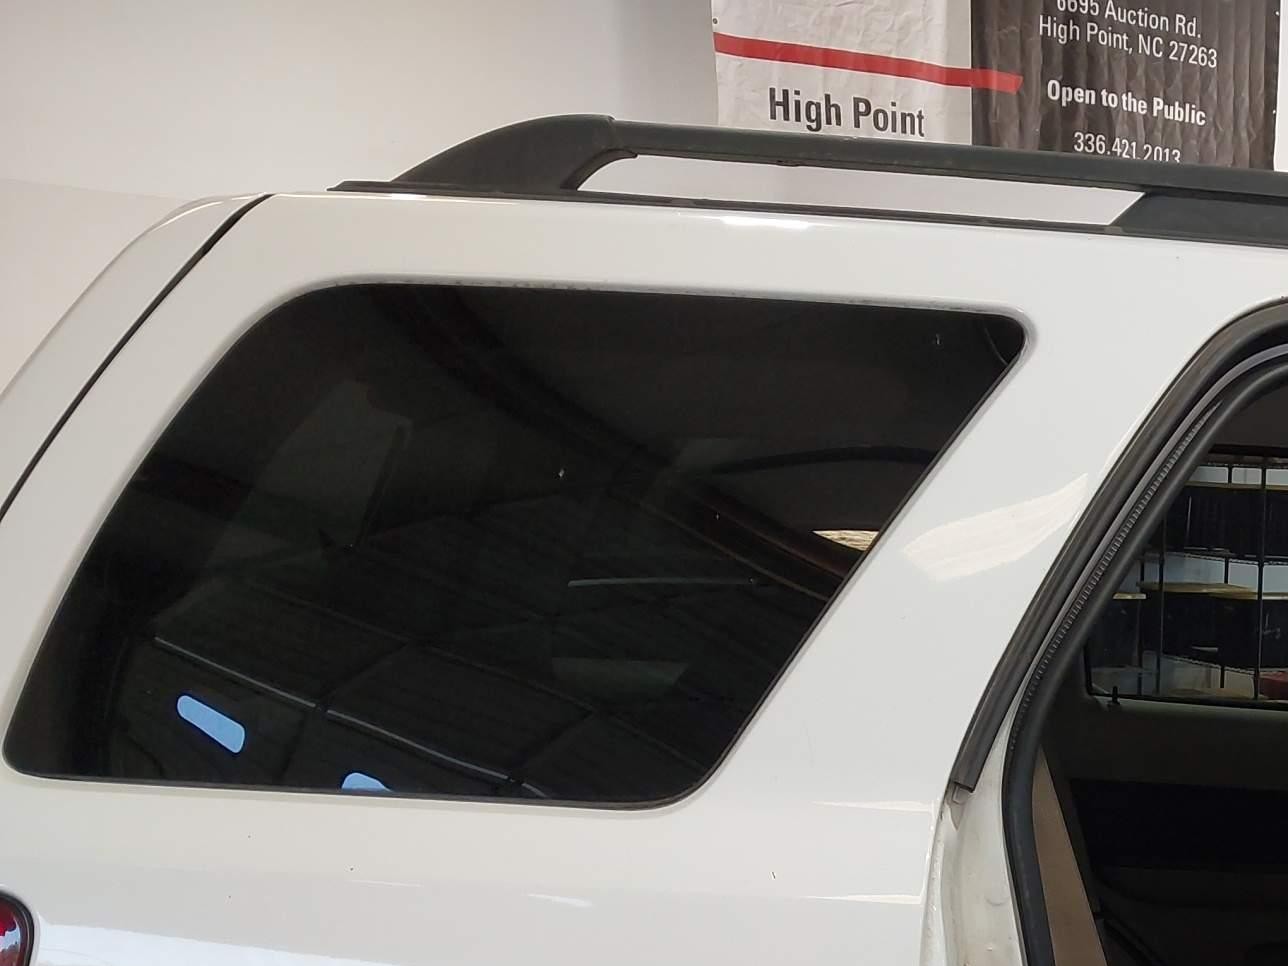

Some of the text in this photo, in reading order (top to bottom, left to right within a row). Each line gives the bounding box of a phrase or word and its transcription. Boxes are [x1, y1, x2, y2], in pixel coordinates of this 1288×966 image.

[1039, 15, 1218, 68] High Point, NC 27263
[1104, 0, 1170, 32] Auction
[1175, 13, 1202, 38] Rd.
[769, 86, 926, 137] High Point
[1047, 79, 1207, 126] Open to the Public
[1073, 131, 1181, 163] 336.421.2013
